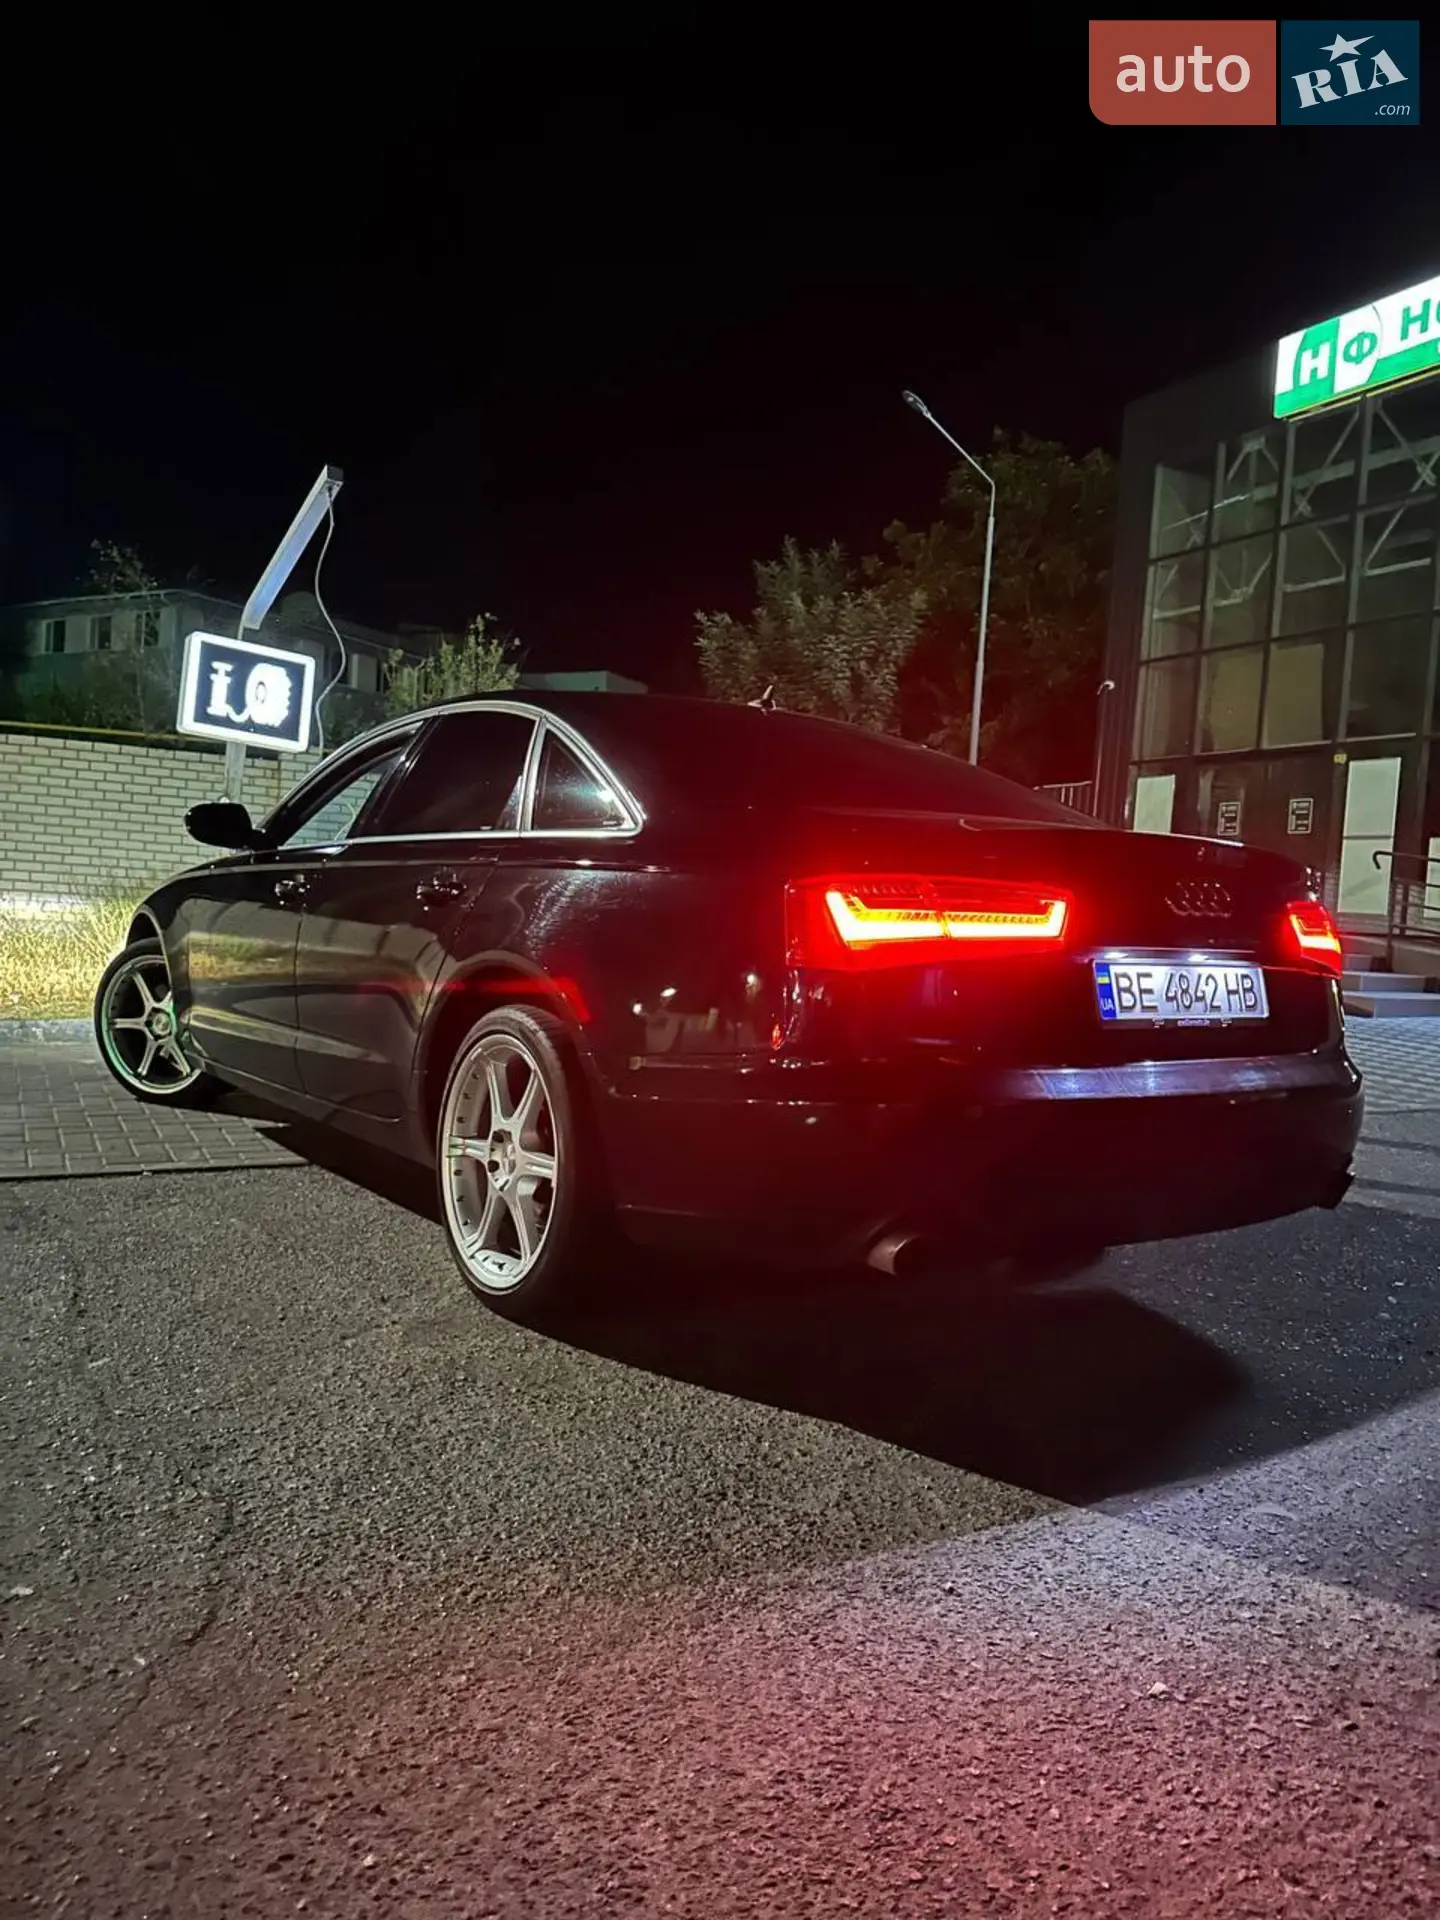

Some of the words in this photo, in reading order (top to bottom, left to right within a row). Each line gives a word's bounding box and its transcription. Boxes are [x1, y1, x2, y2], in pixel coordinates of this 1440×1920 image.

[1400, 298, 1440, 341] Н
[1101, 997, 1115, 1011] UA
[1114, 972, 1159, 1013] BE
[1165, 972, 1222, 1013] 4842
[1224, 973, 1259, 1012] HB
